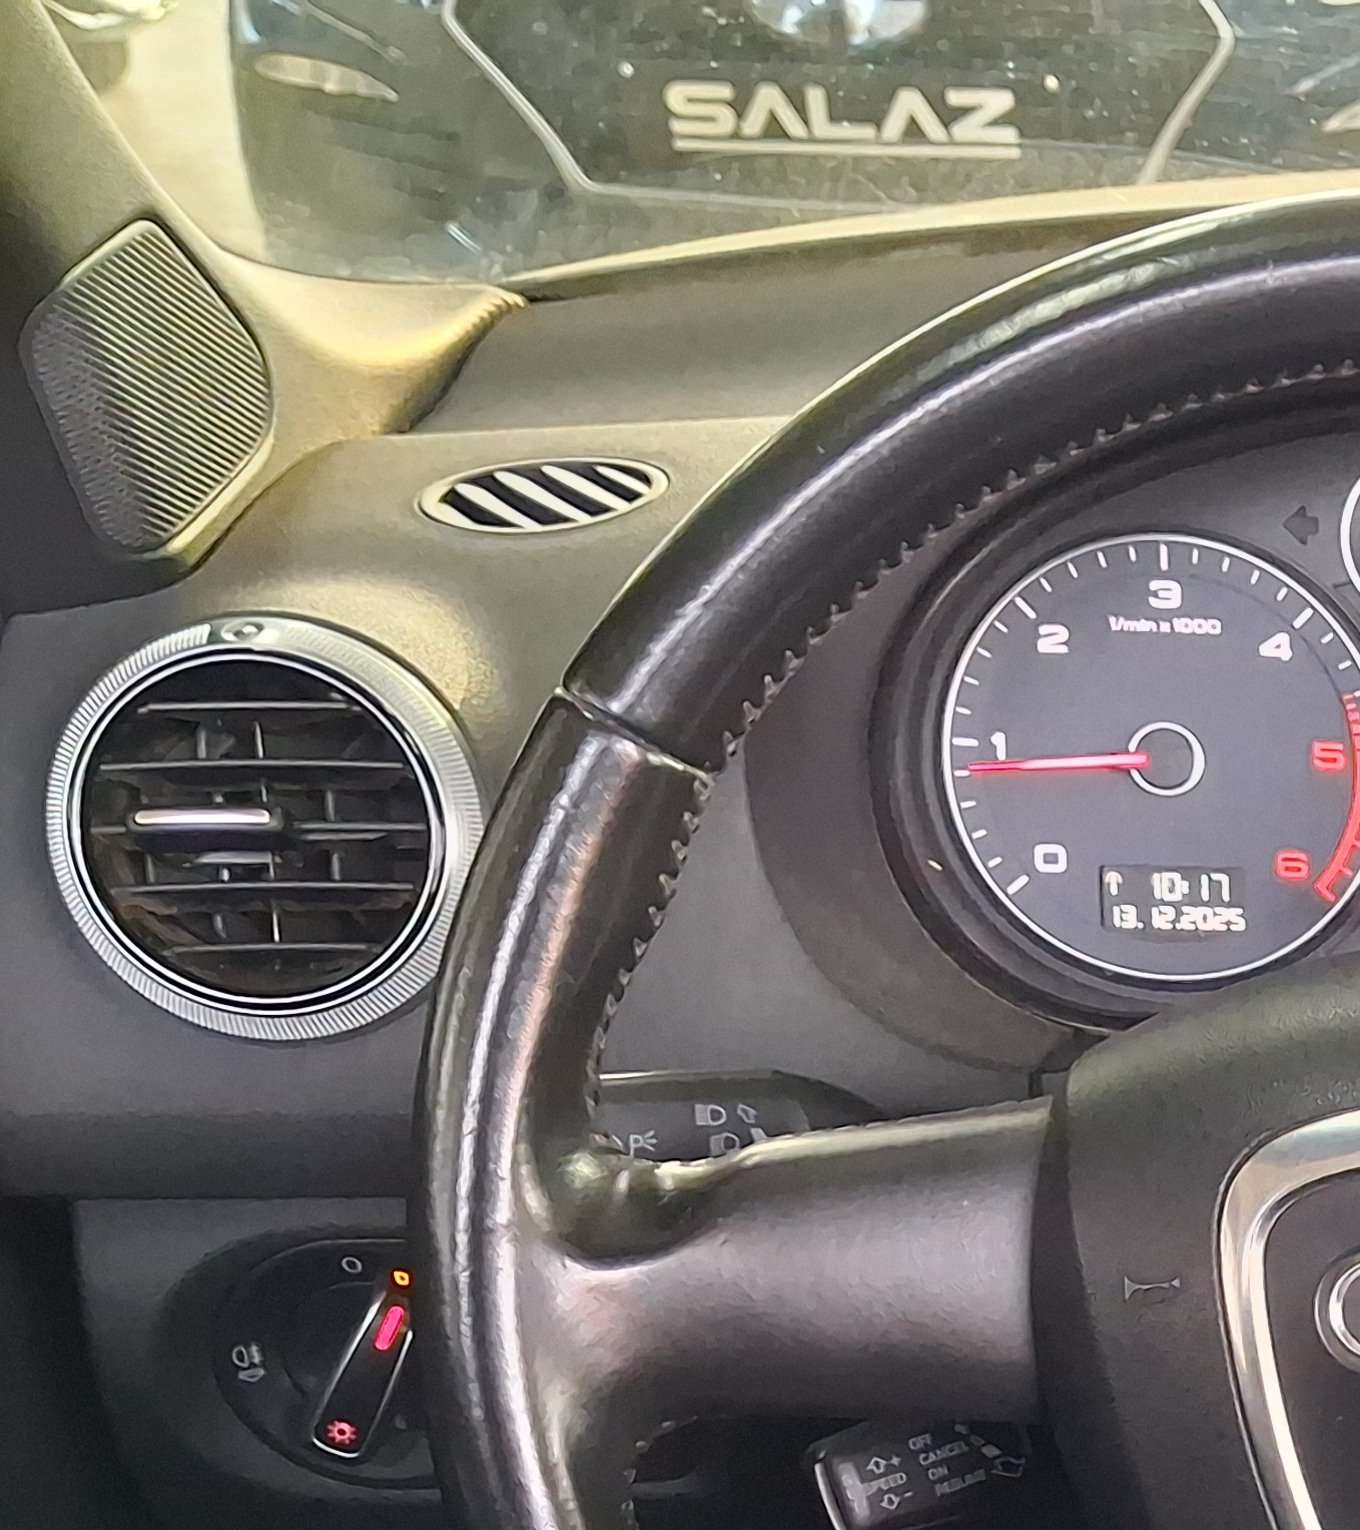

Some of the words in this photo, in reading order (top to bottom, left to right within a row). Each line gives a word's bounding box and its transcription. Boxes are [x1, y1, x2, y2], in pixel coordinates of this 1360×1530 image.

[663, 79, 1022, 144] SALAZ
[1148, 579, 1183, 610] 3
[1036, 622, 1071, 655] 2
[1258, 631, 1293, 662] 4
[989, 731, 1008, 761] 1
[1311, 741, 1346, 771] 5
[1034, 843, 1068, 873] 0
[1274, 851, 1310, 880] 6
[1151, 872, 1231, 902] 10:17
